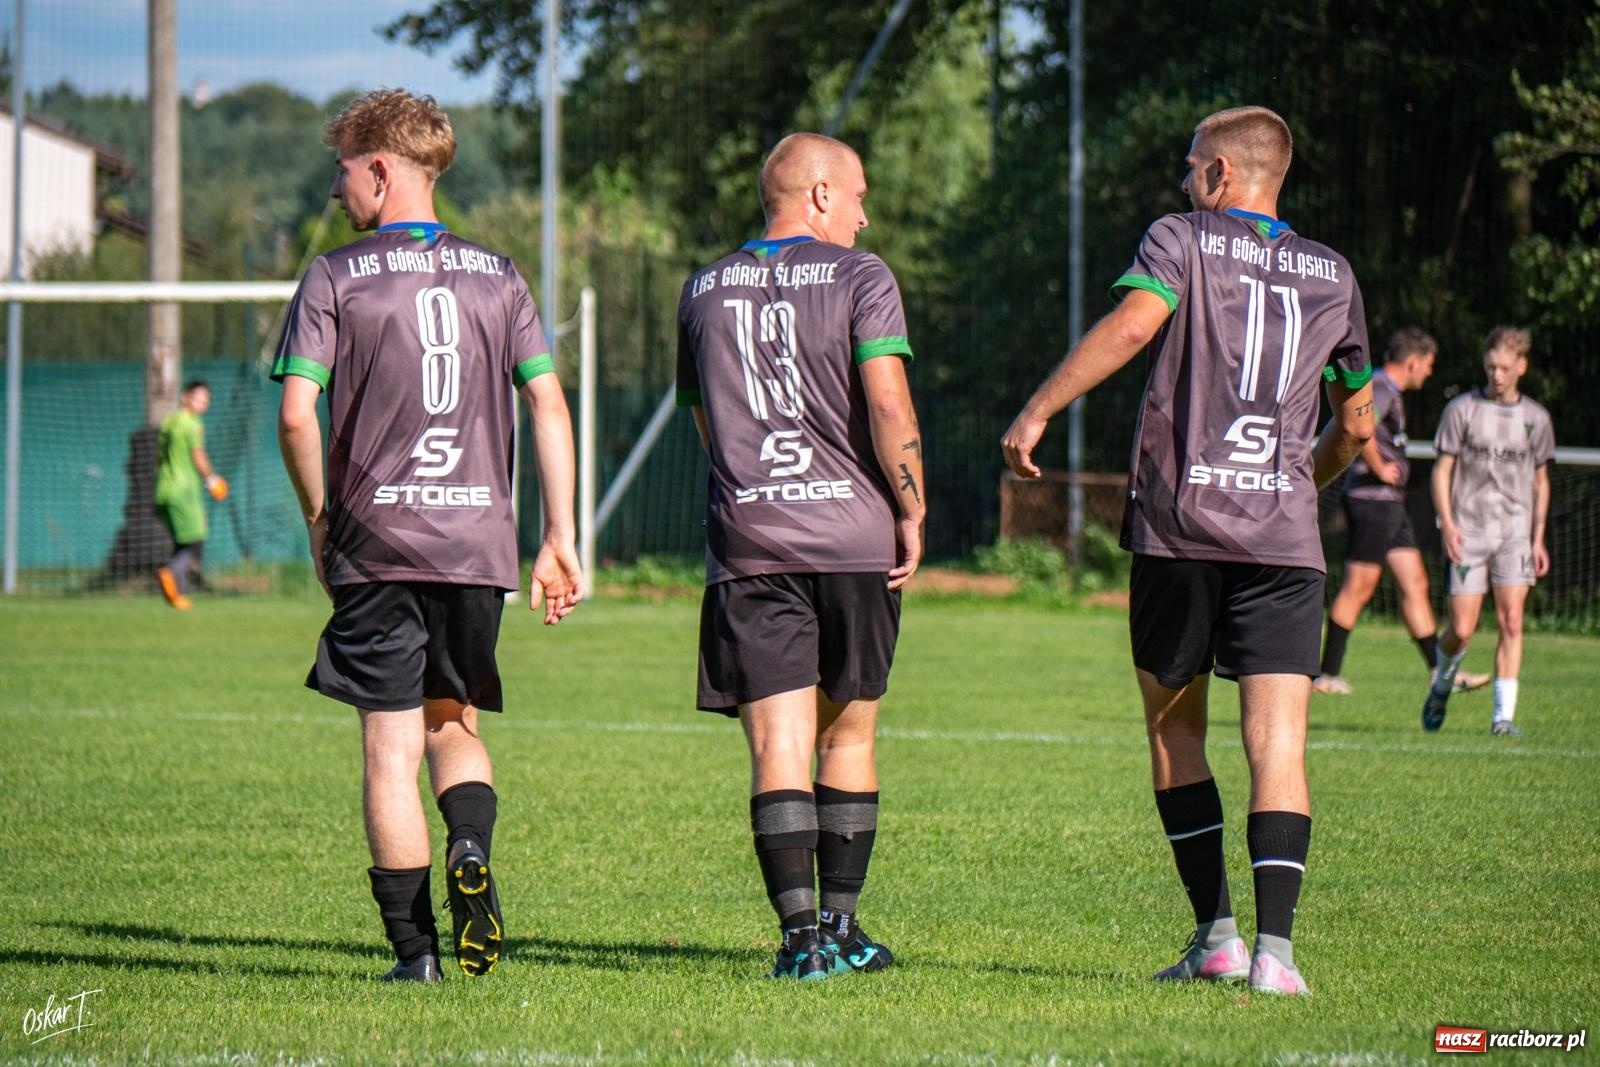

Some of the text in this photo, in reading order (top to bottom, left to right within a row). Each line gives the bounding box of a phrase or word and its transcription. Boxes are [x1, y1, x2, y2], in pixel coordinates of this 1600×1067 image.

[347, 246, 504, 278] LKS GÓRKI ŚLĄSKIE
[1200, 230, 1340, 284] LKS GÓRKI ŚLĄSKIE
[692, 262, 838, 299] LKS GÓRKI ŚLĄSKIE
[415, 286, 461, 416] 8
[1239, 275, 1302, 405] 11
[723, 299, 805, 421] 13
[373, 485, 493, 507] STAGE
[735, 479, 855, 505] STAGE
[1187, 465, 1294, 492] STAGE
